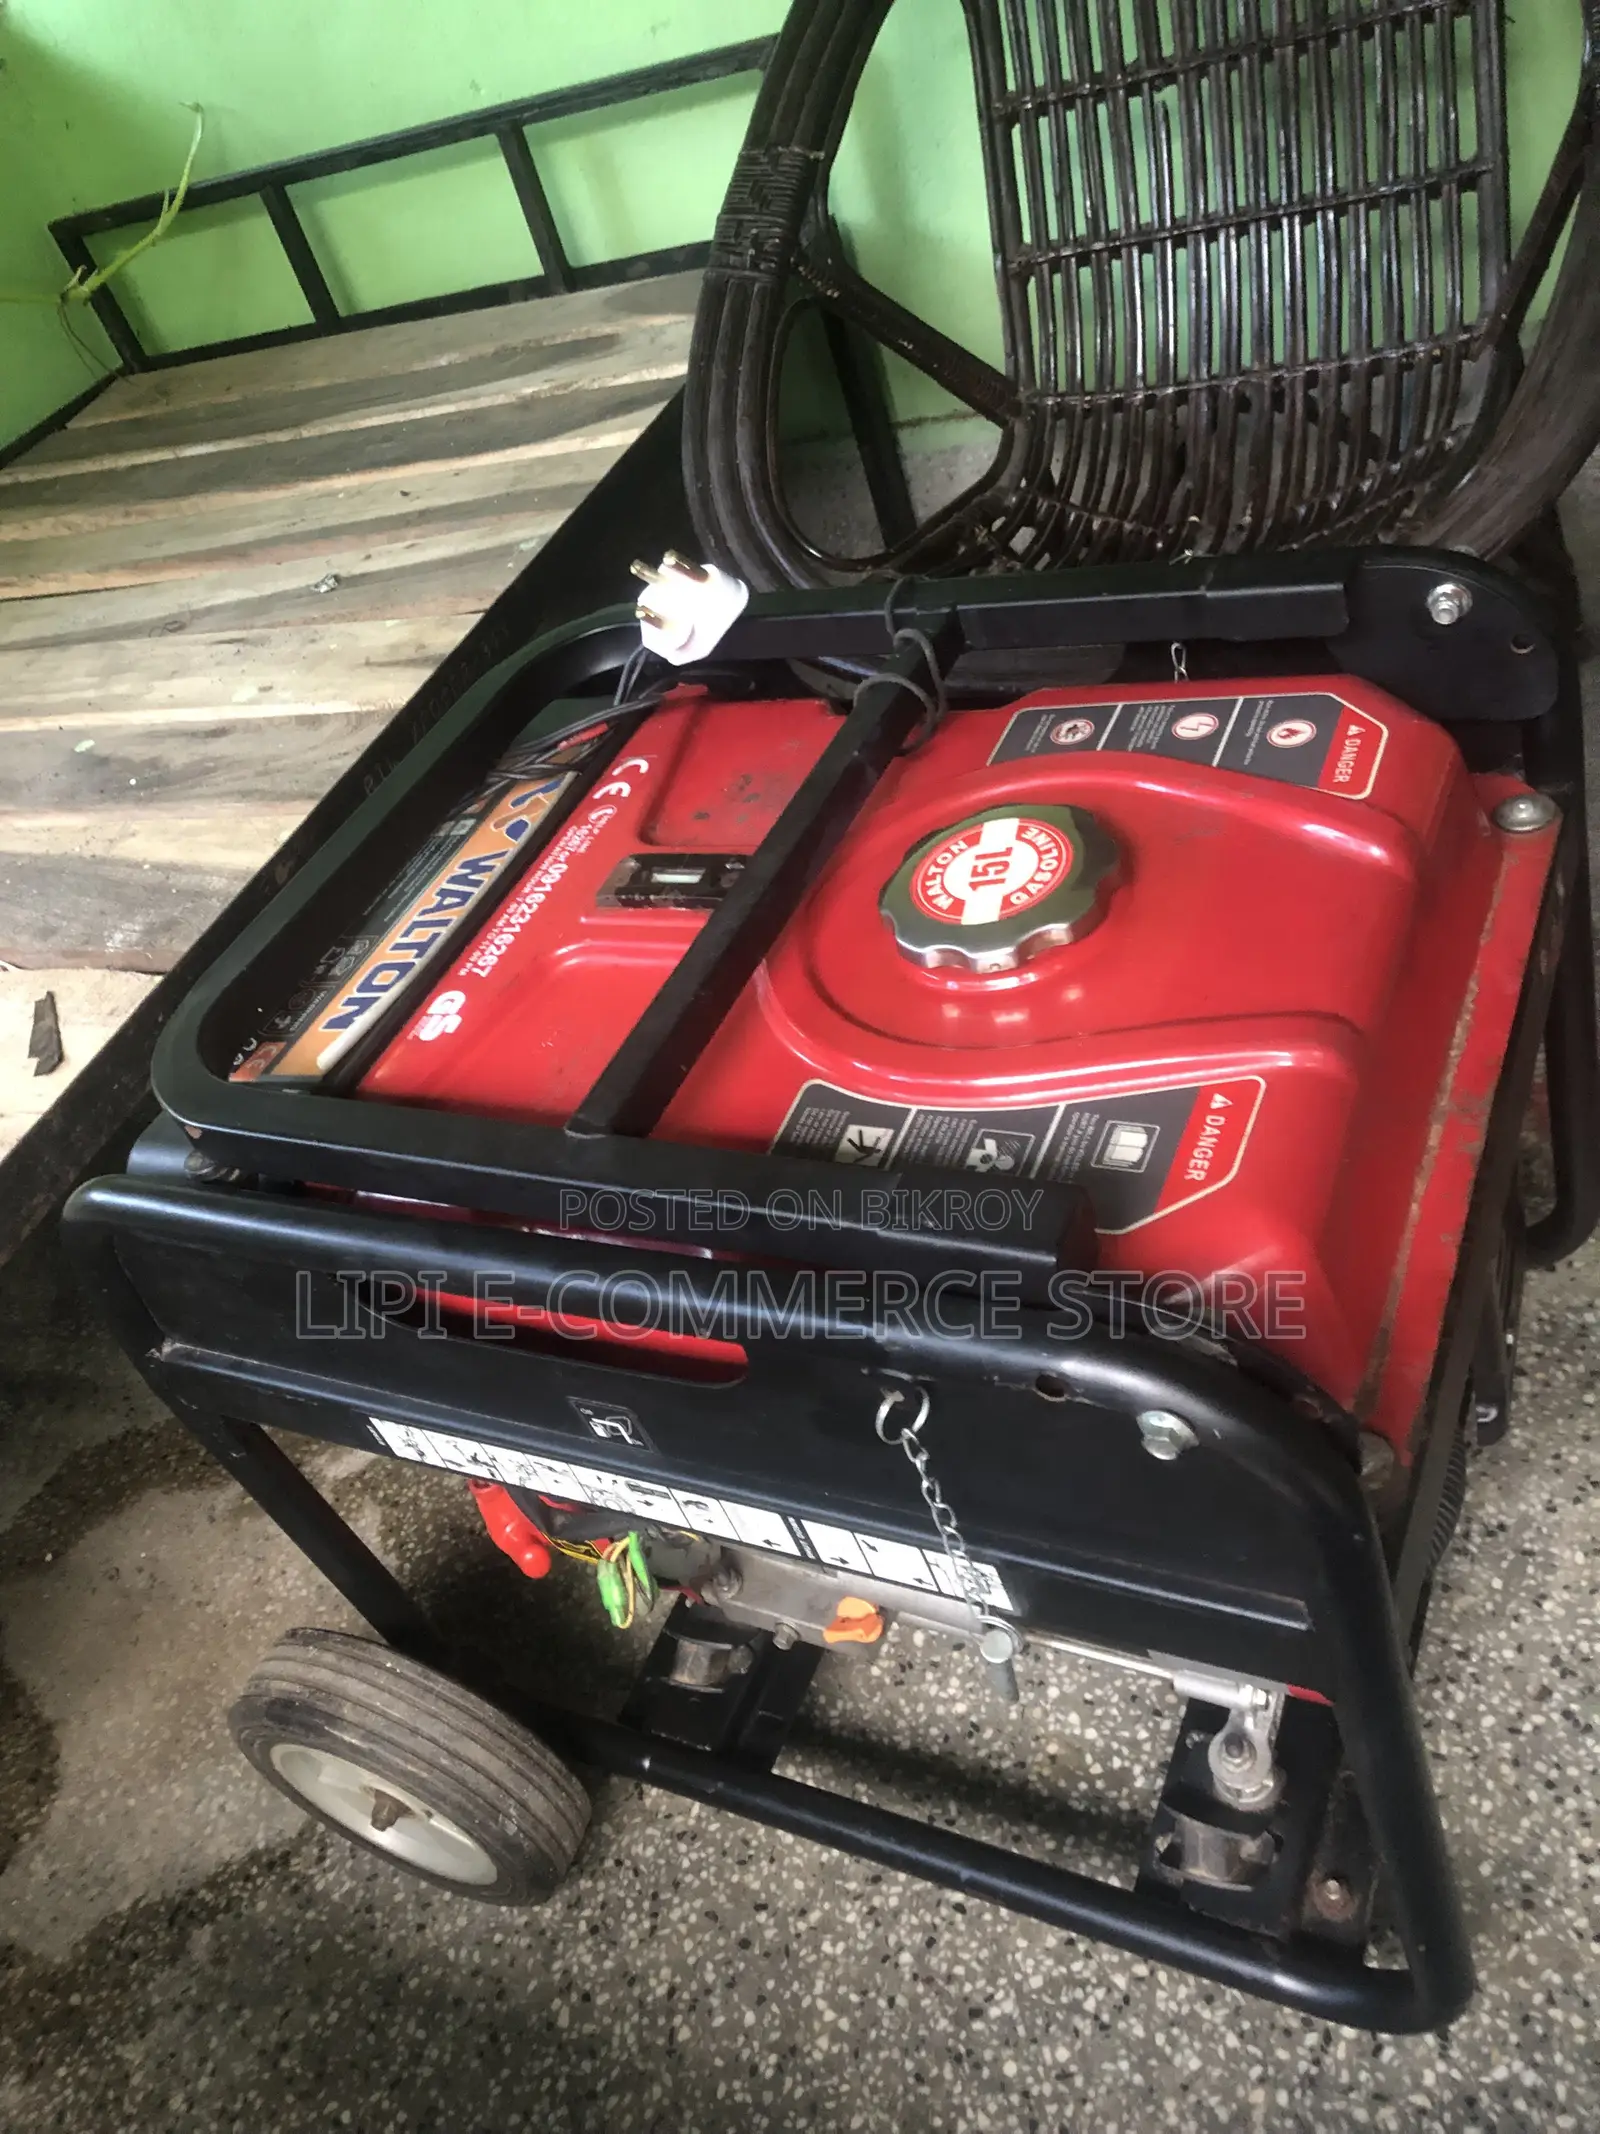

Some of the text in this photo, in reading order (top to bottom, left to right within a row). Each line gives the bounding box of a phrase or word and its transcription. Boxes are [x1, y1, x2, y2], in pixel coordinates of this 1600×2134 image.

[592, 758, 649, 799] CE
[1332, 738, 1362, 783] DANGER
[925, 840, 969, 911] WALTON
[1009, 826, 1059, 905] GASOLINE
[319, 848, 512, 1031] WALTON
[1183, 1114, 1226, 1181] DANGER
